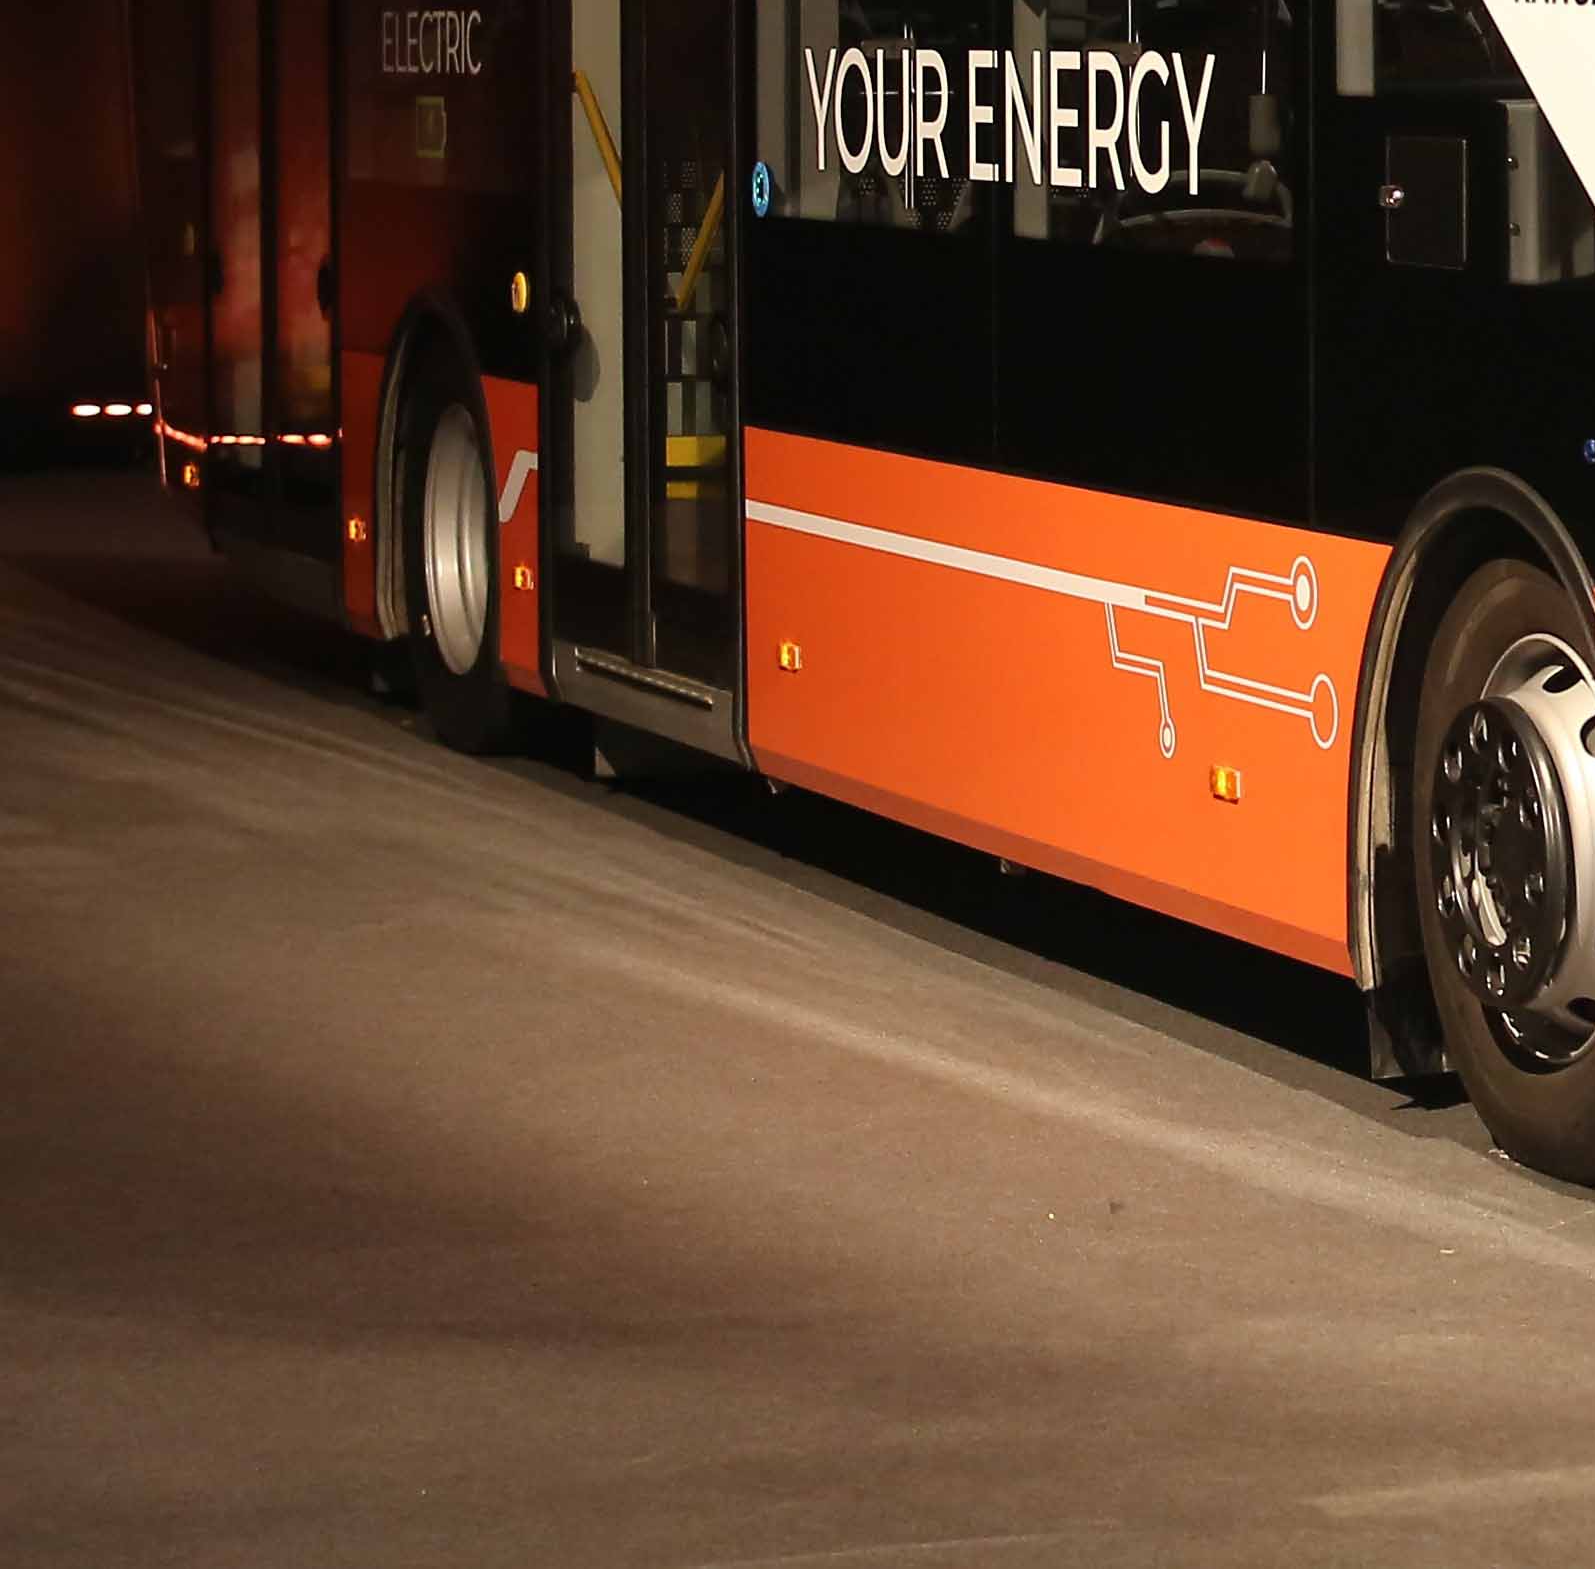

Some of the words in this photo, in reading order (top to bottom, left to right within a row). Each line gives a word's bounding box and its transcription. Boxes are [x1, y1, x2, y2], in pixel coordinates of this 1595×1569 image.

[383, 10, 482, 75] ELECTRIC
[805, 47, 949, 179] YOUR
[968, 49, 1215, 195] ENERGY
